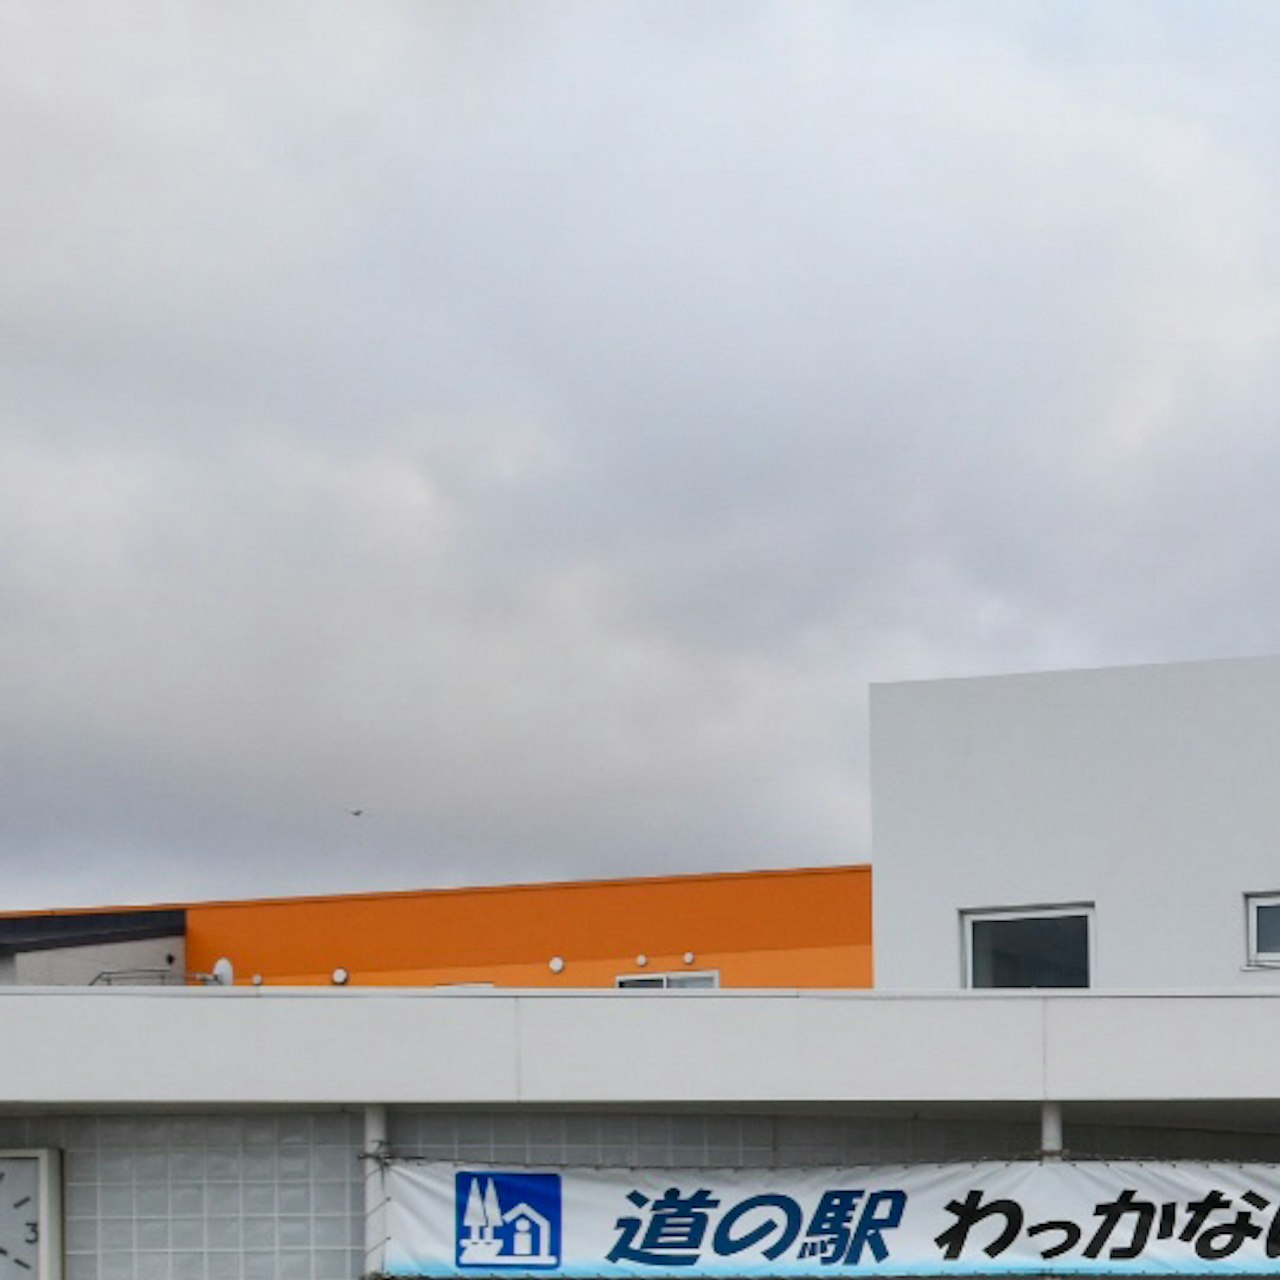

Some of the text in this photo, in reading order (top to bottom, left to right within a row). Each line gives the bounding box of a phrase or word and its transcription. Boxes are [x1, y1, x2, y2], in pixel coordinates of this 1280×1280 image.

[25, 1222, 39, 1244] 3
[604, 1187, 908, 1266] 道の駅
